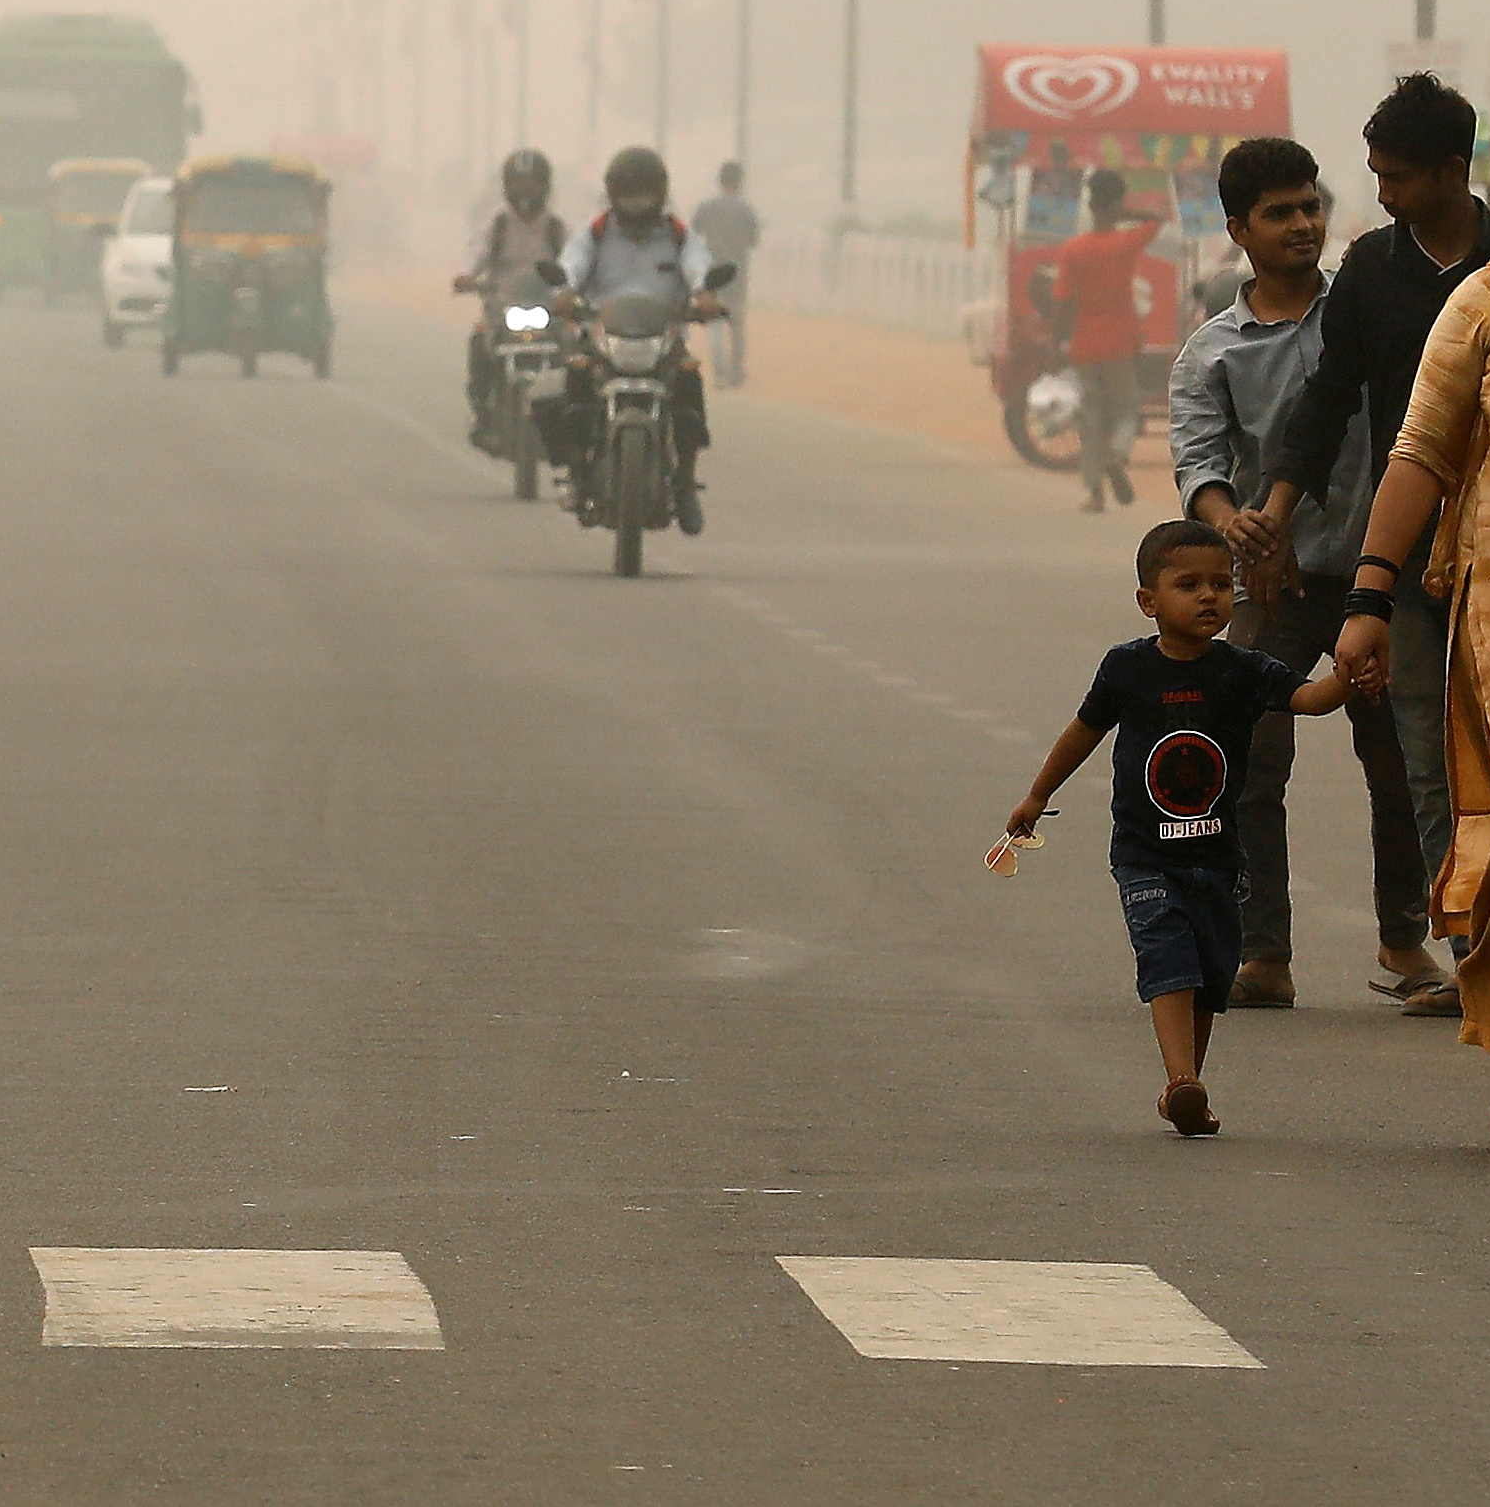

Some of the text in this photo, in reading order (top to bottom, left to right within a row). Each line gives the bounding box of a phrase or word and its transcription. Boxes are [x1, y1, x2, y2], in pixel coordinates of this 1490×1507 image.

[1149, 63, 1270, 82] KWALITY
[1164, 84, 1256, 110] WALL'S
[1161, 819, 1221, 838] DJ-JEANS
